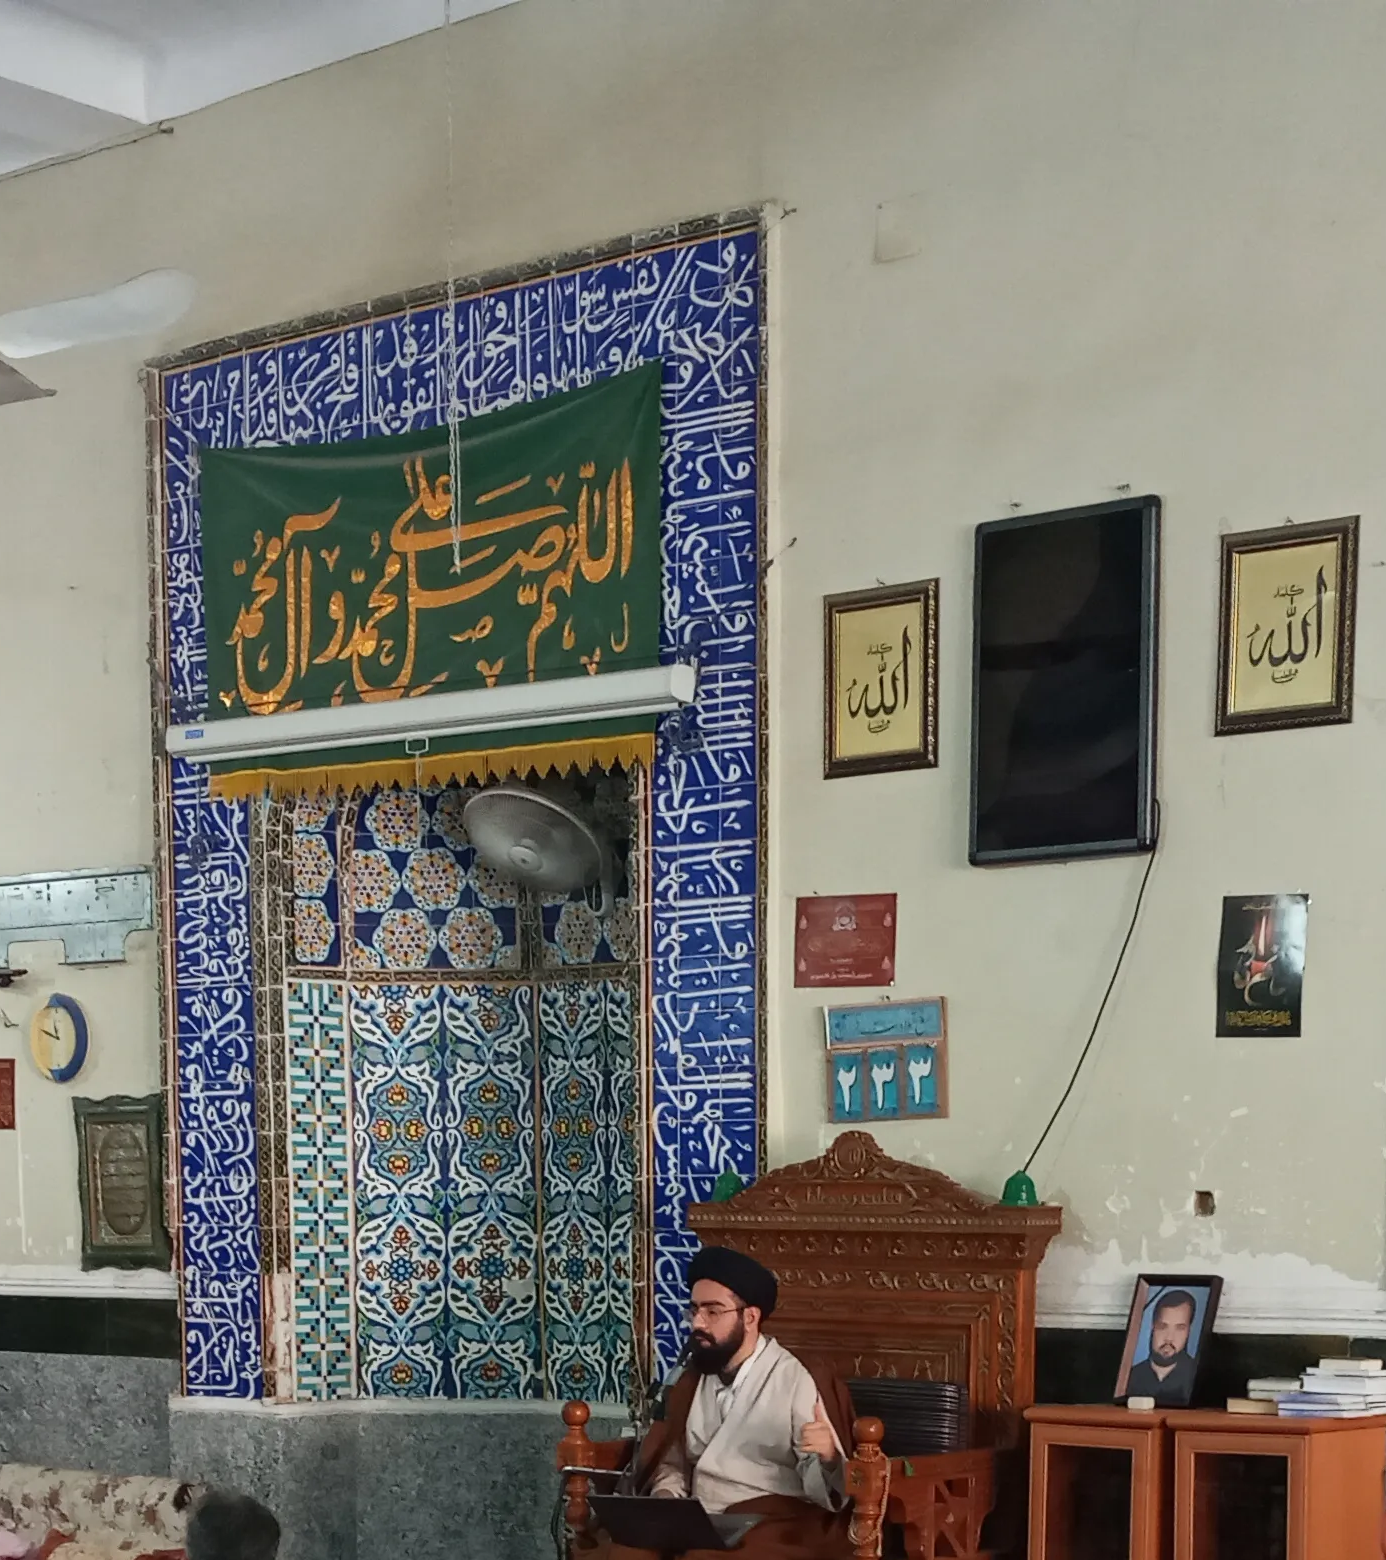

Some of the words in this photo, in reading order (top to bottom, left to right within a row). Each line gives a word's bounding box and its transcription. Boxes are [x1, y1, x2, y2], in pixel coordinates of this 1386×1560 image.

[225, 536, 284, 647] محمد
[338, 548, 402, 661] محمد
[1247, 565, 1328, 668] الله
[846, 624, 912, 719] الله
